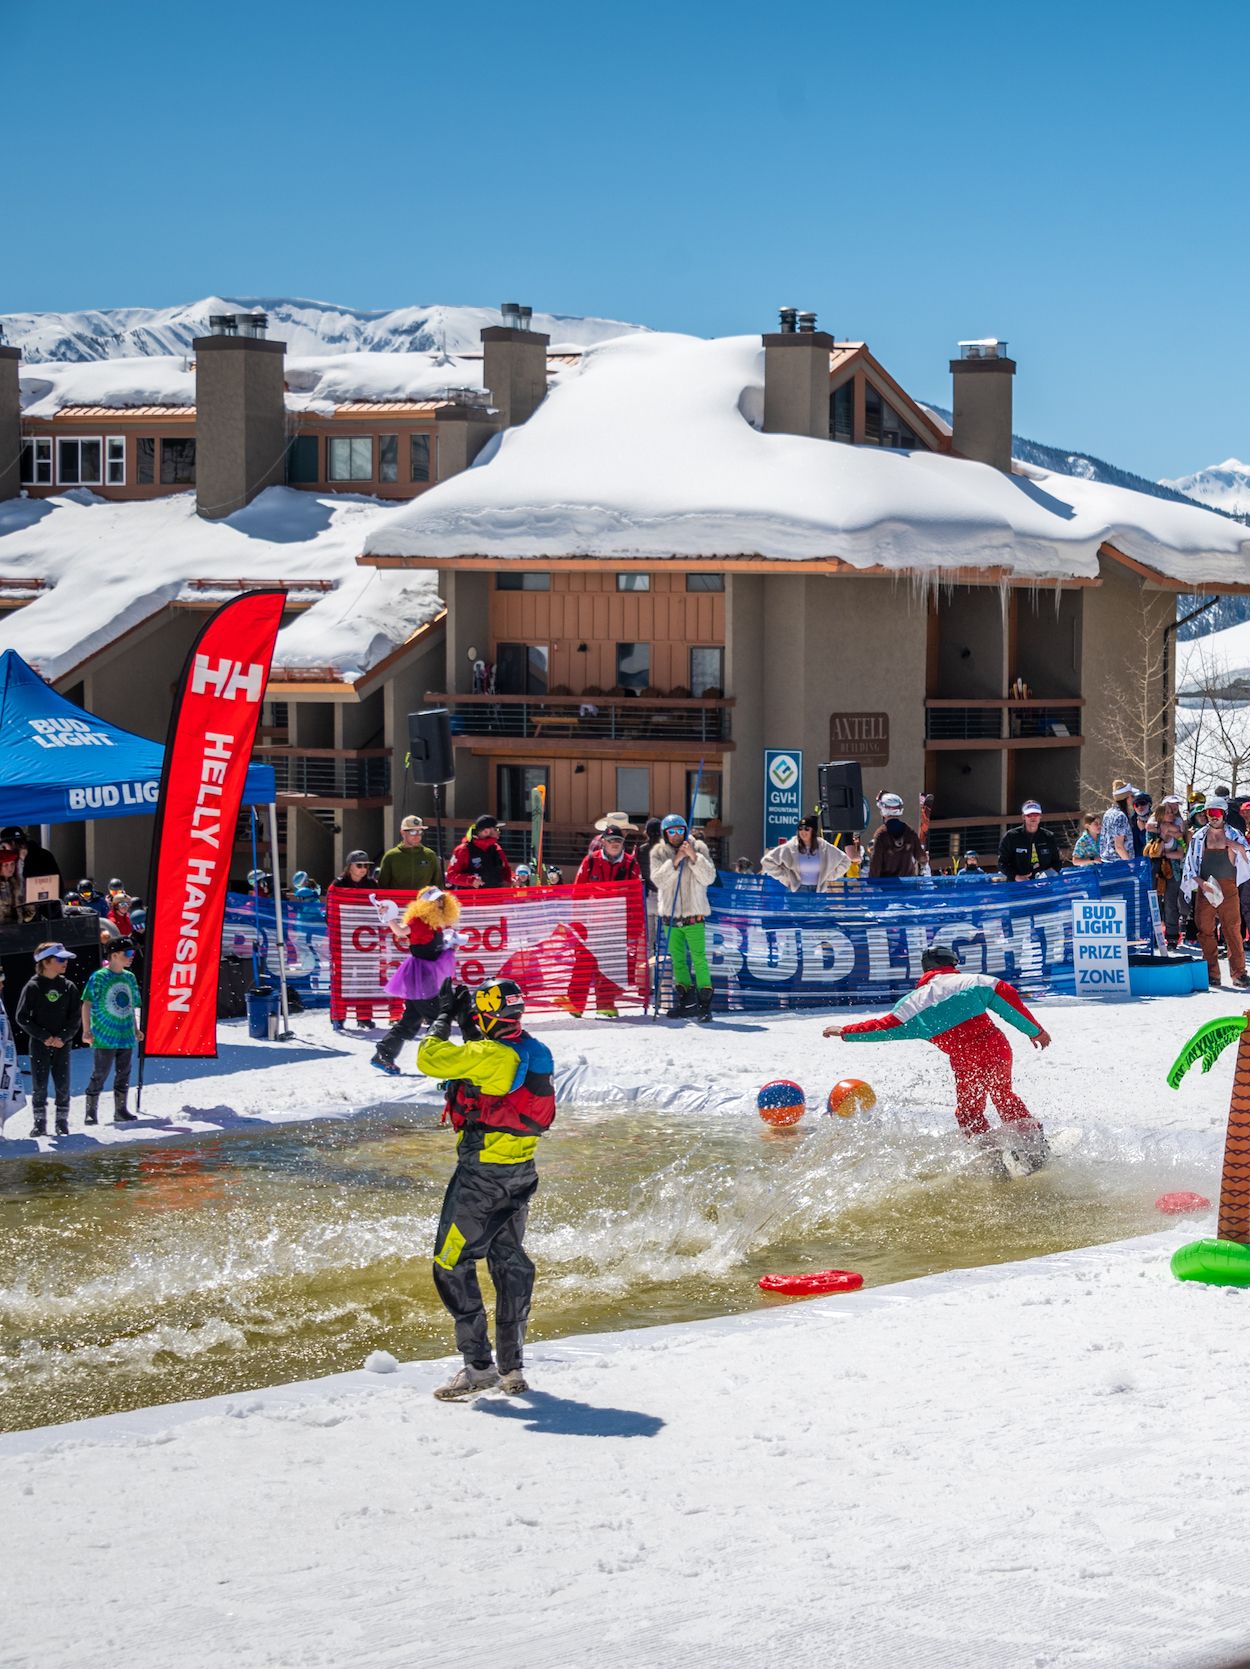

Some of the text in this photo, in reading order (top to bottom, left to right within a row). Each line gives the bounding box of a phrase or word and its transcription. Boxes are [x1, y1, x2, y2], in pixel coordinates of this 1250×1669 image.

[28, 718, 91, 734] BUD
[832, 717, 888, 740] AXTELL
[32, 732, 115, 748] LIGHT
[69, 781, 160, 810] BUD LIG
[770, 791, 797, 804] GVH
[768, 815, 798, 825] CLINIC
[167, 731, 234, 1012] HELLY HANSEN
[1082, 906, 1117, 920] BUD
[1076, 920, 1122, 934] LIGHT
[705, 910, 1073, 983] BUD LIGHT
[1079, 945, 1122, 959] PRIZE
[1079, 970, 1125, 984] ZONE
